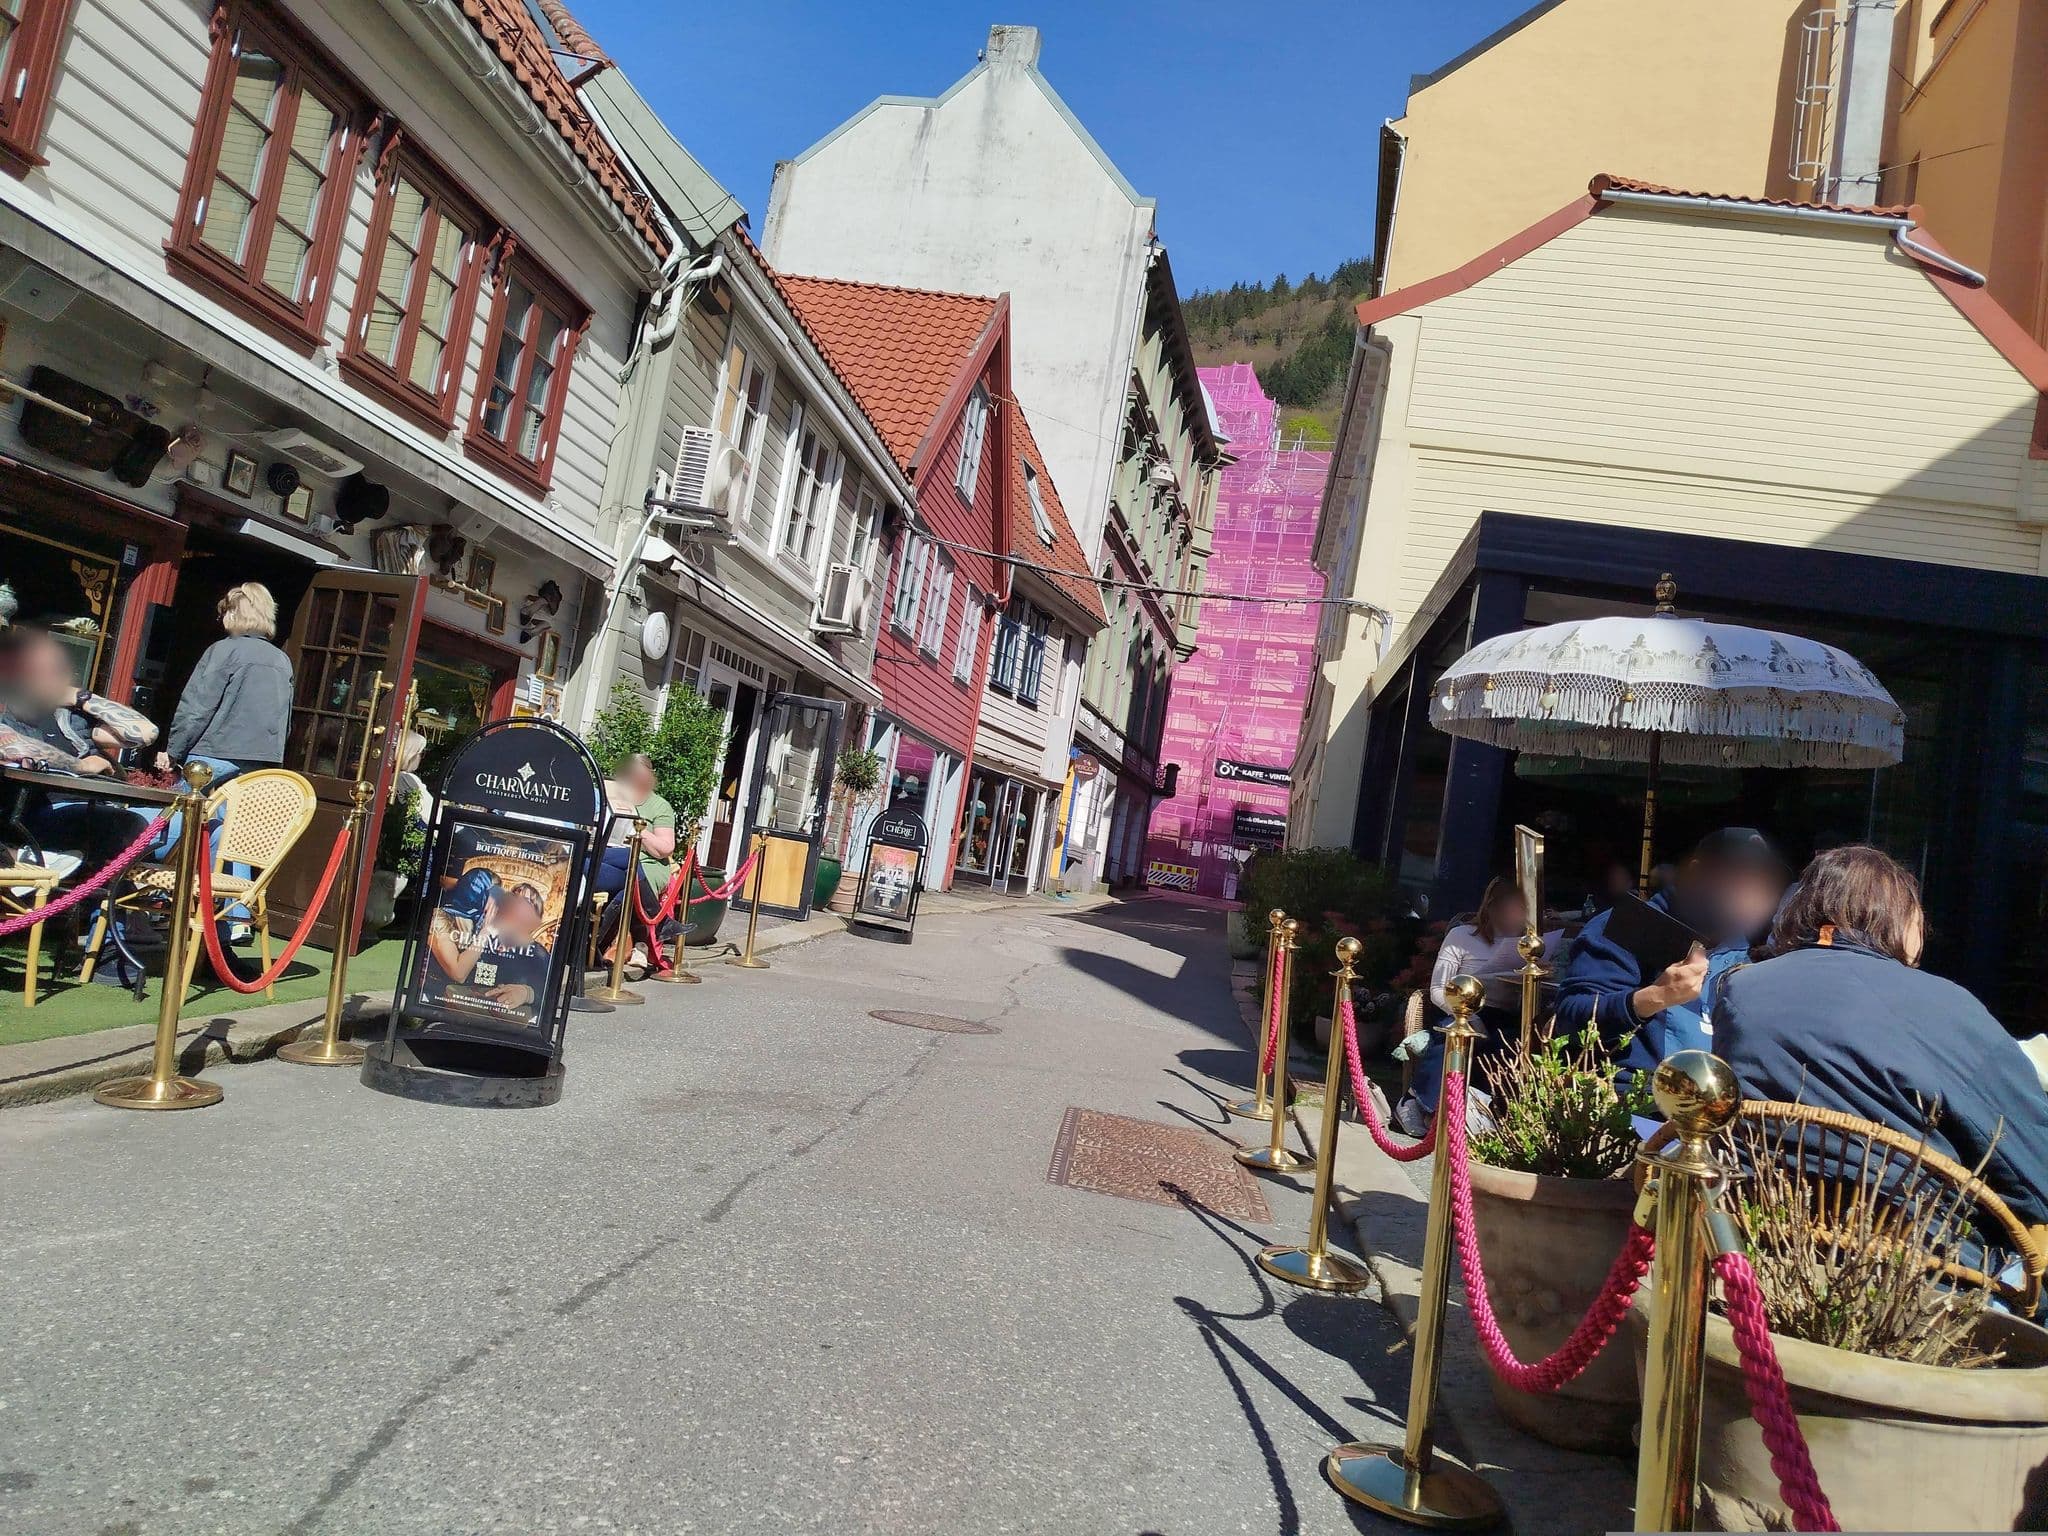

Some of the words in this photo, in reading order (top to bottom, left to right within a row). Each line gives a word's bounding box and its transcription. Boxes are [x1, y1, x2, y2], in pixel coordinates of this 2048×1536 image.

[1242, 769, 1265, 778] KAFFE
[475, 772, 571, 801] CHARMANTE
[476, 841, 517, 858] BOUTIQUE
[519, 849, 545, 863] HOTEL
